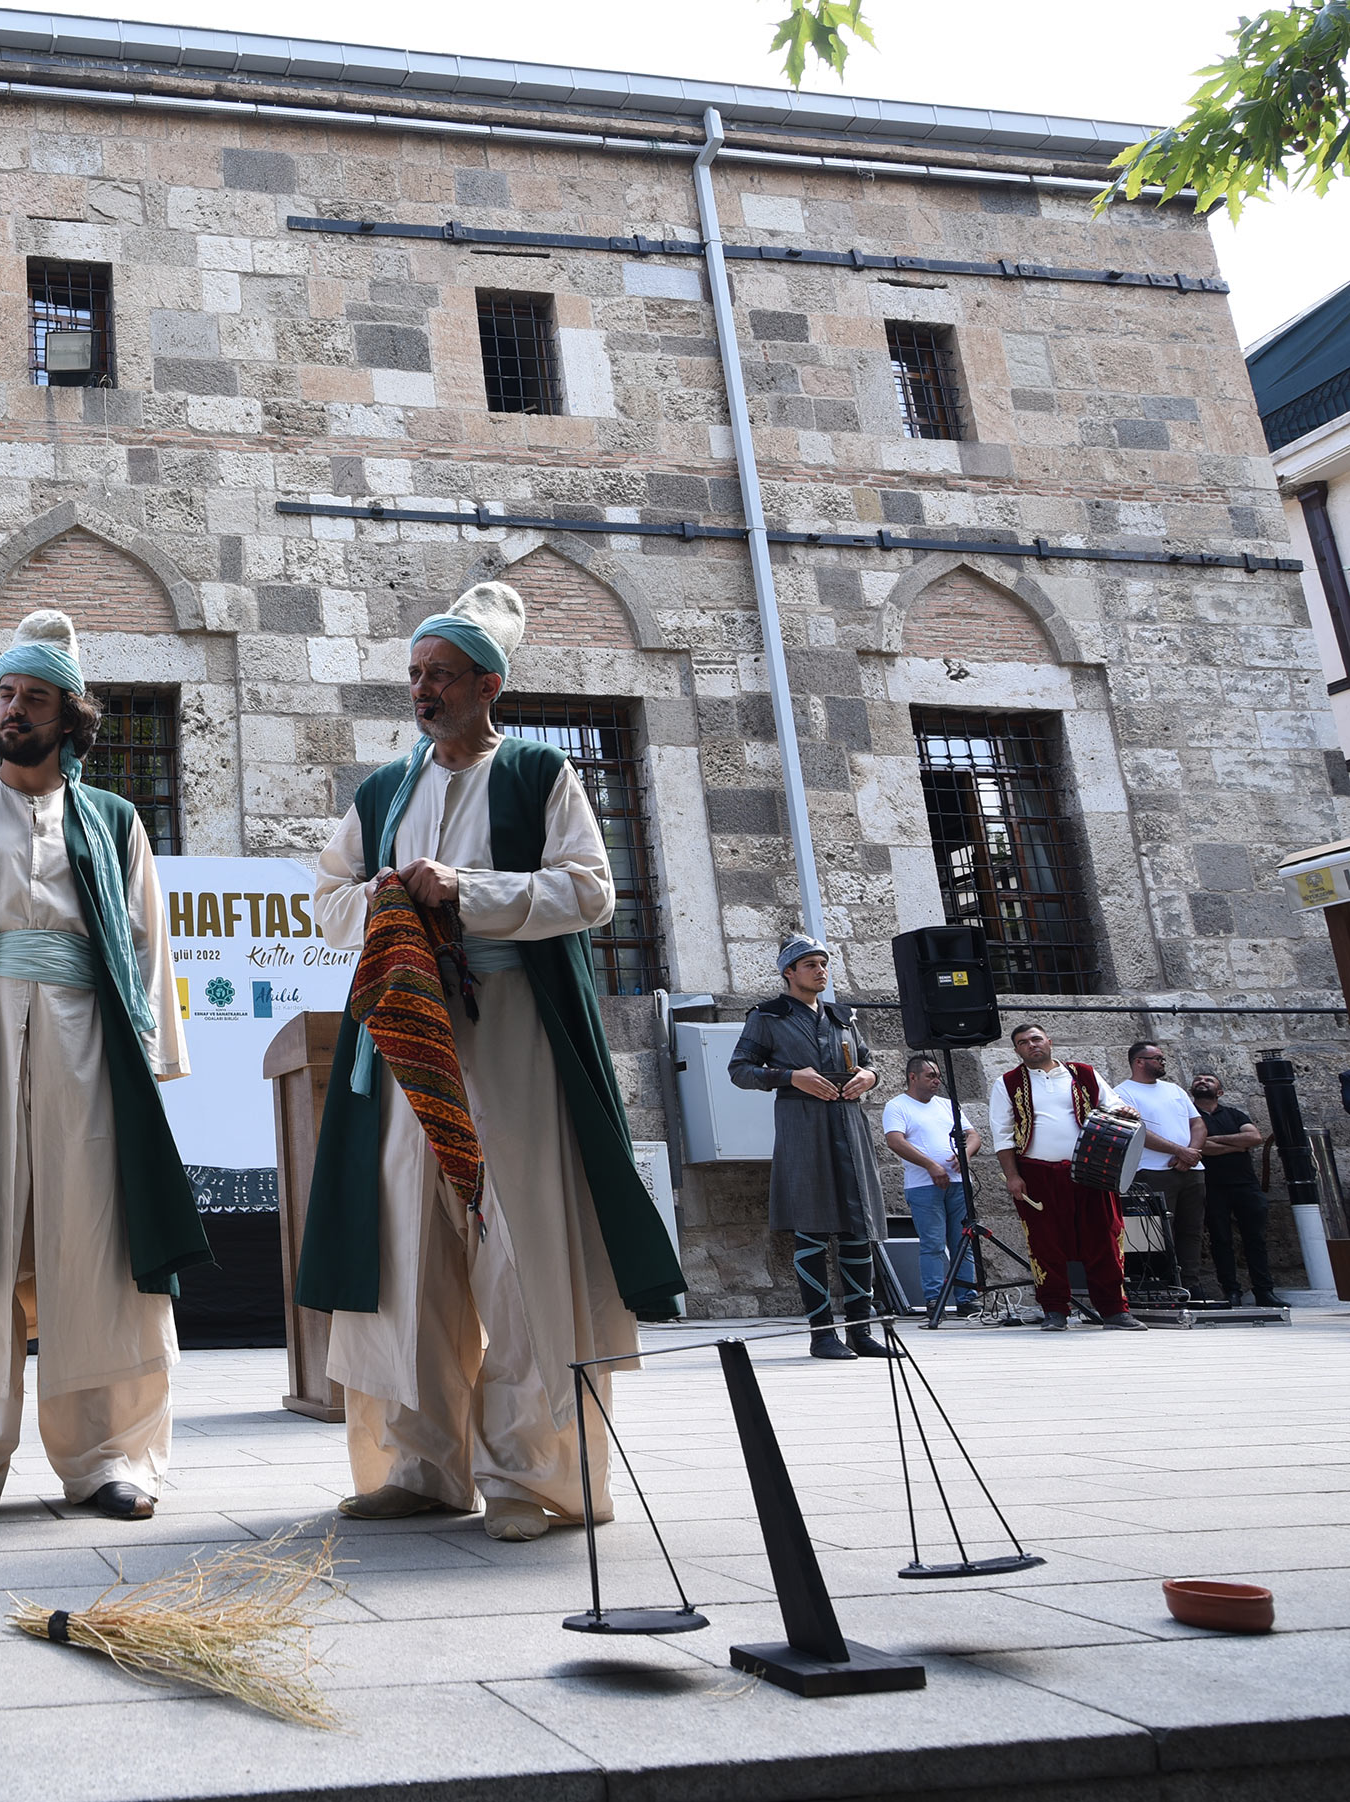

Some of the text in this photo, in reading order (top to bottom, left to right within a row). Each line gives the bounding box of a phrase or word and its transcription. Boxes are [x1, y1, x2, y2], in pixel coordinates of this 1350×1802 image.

[169, 892, 324, 938] HAFTAS
[170, 949, 221, 962] ylül 2022
[246, 943, 355, 968] Kutlu Olsun
